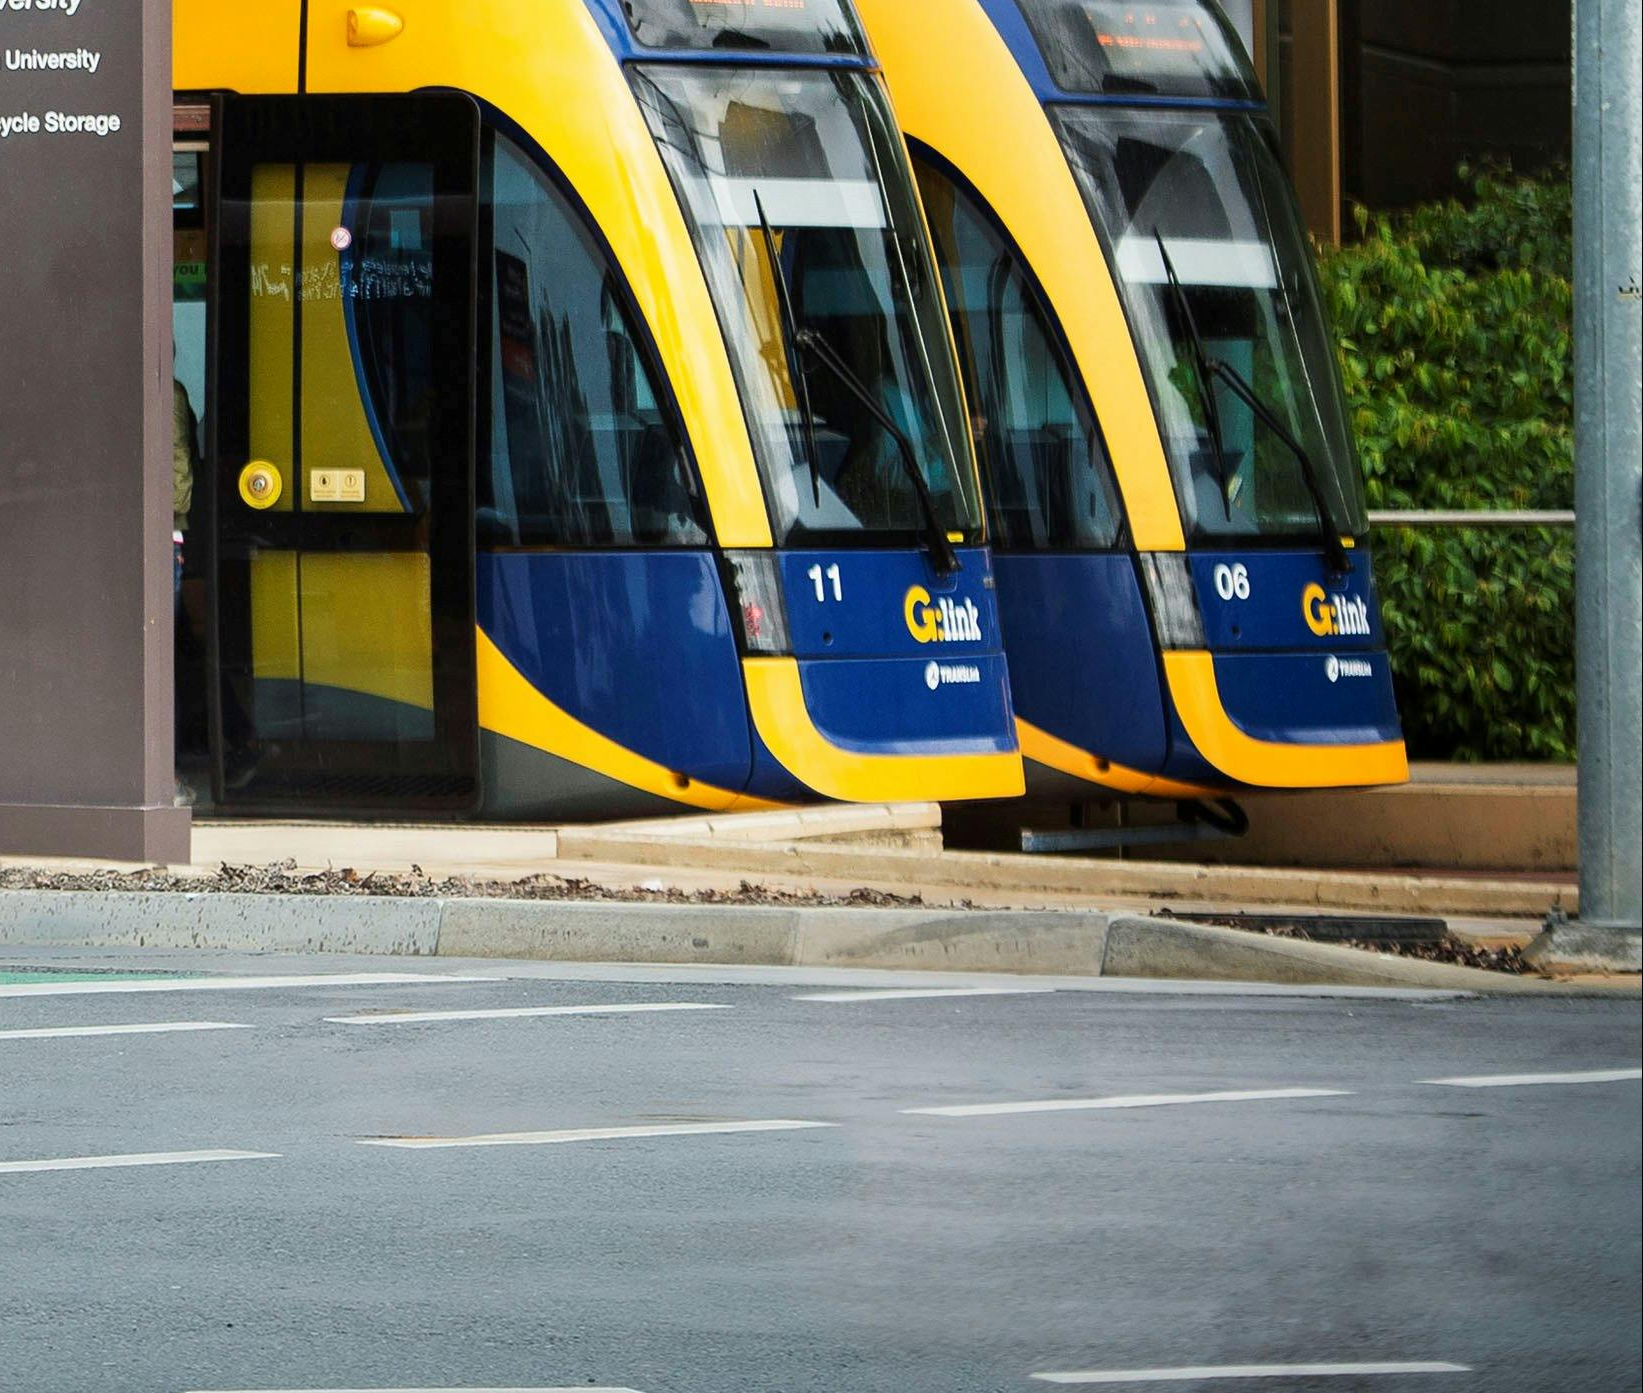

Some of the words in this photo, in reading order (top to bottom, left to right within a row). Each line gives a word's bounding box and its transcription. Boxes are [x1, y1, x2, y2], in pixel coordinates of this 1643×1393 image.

[5, 47, 101, 74] University
[44, 110, 121, 136] Storage
[807, 562, 843, 603] 11
[1214, 562, 1251, 601] 06
